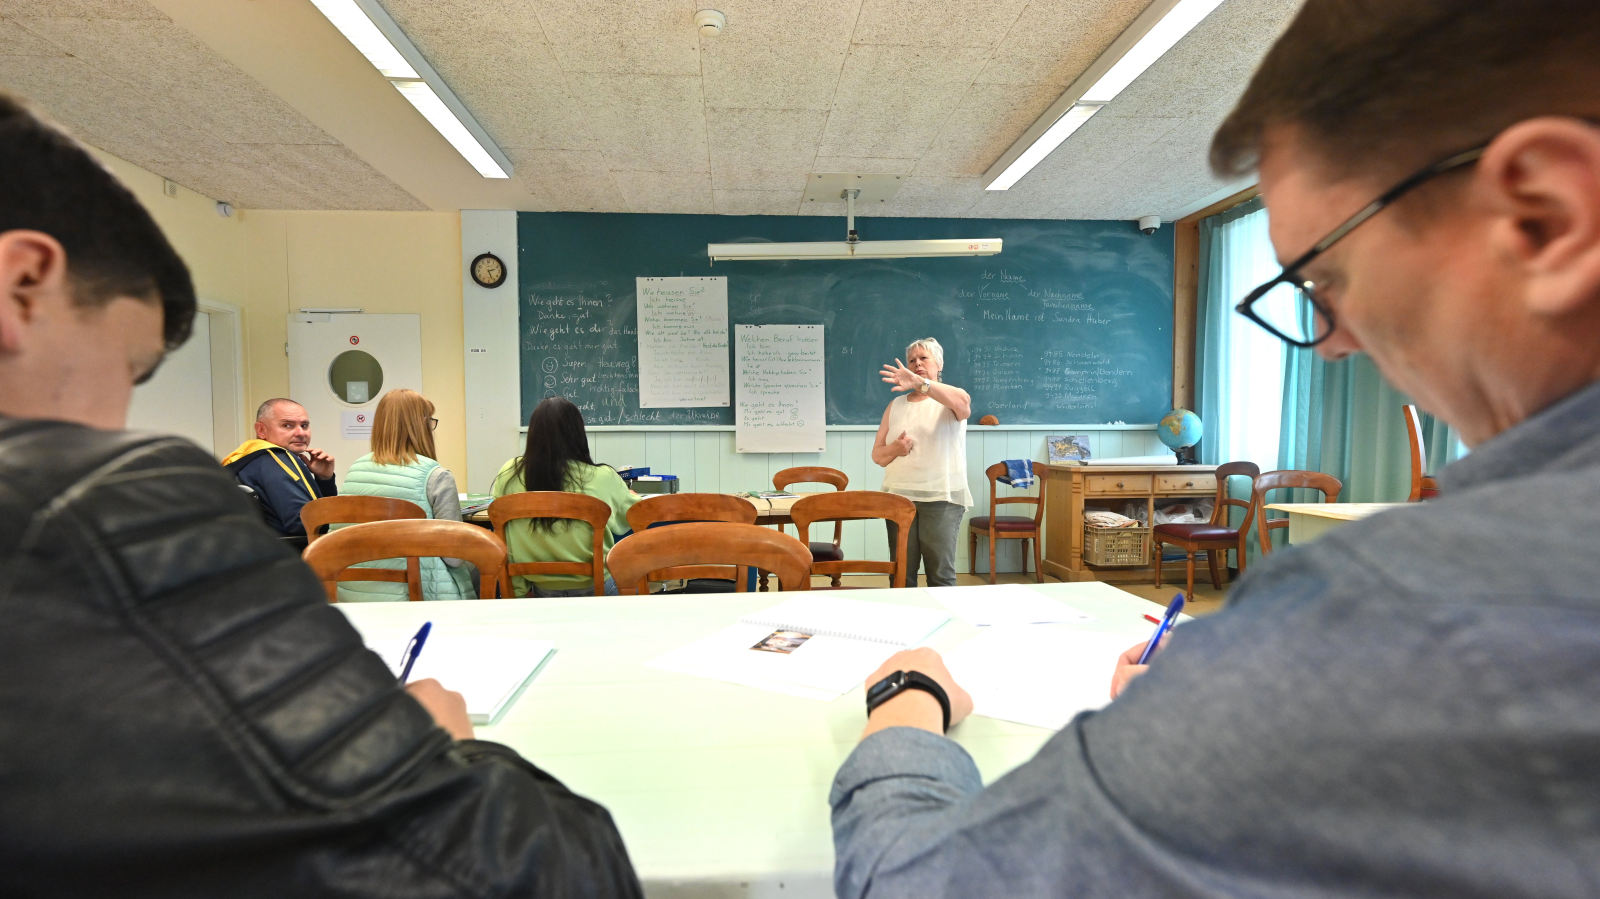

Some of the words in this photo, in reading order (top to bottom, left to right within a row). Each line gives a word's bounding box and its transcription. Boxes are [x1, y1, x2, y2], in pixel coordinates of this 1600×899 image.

[981, 270, 996, 280] der
[1001, 270, 1023, 280] Name
[959, 289, 975, 298] der
[1028, 289, 1041, 297] der
[1044, 288, 1083, 299] Nachname
[529, 294, 543, 305] Wie
[546, 296, 562, 311] geht
[1043, 300, 1093, 309] Familienname
[984, 310, 1003, 321] Mein
[1006, 308, 1029, 321] Name
[1035, 312, 1044, 321] ist
[1053, 312, 1080, 323] Sandra
[530, 323, 547, 335] Wie
[550, 324, 569, 340] geht
[741, 334, 769, 342] Welchen
[774, 334, 793, 342] Beruf
[602, 395, 626, 407] und
[988, 401, 1027, 410] Oberland
